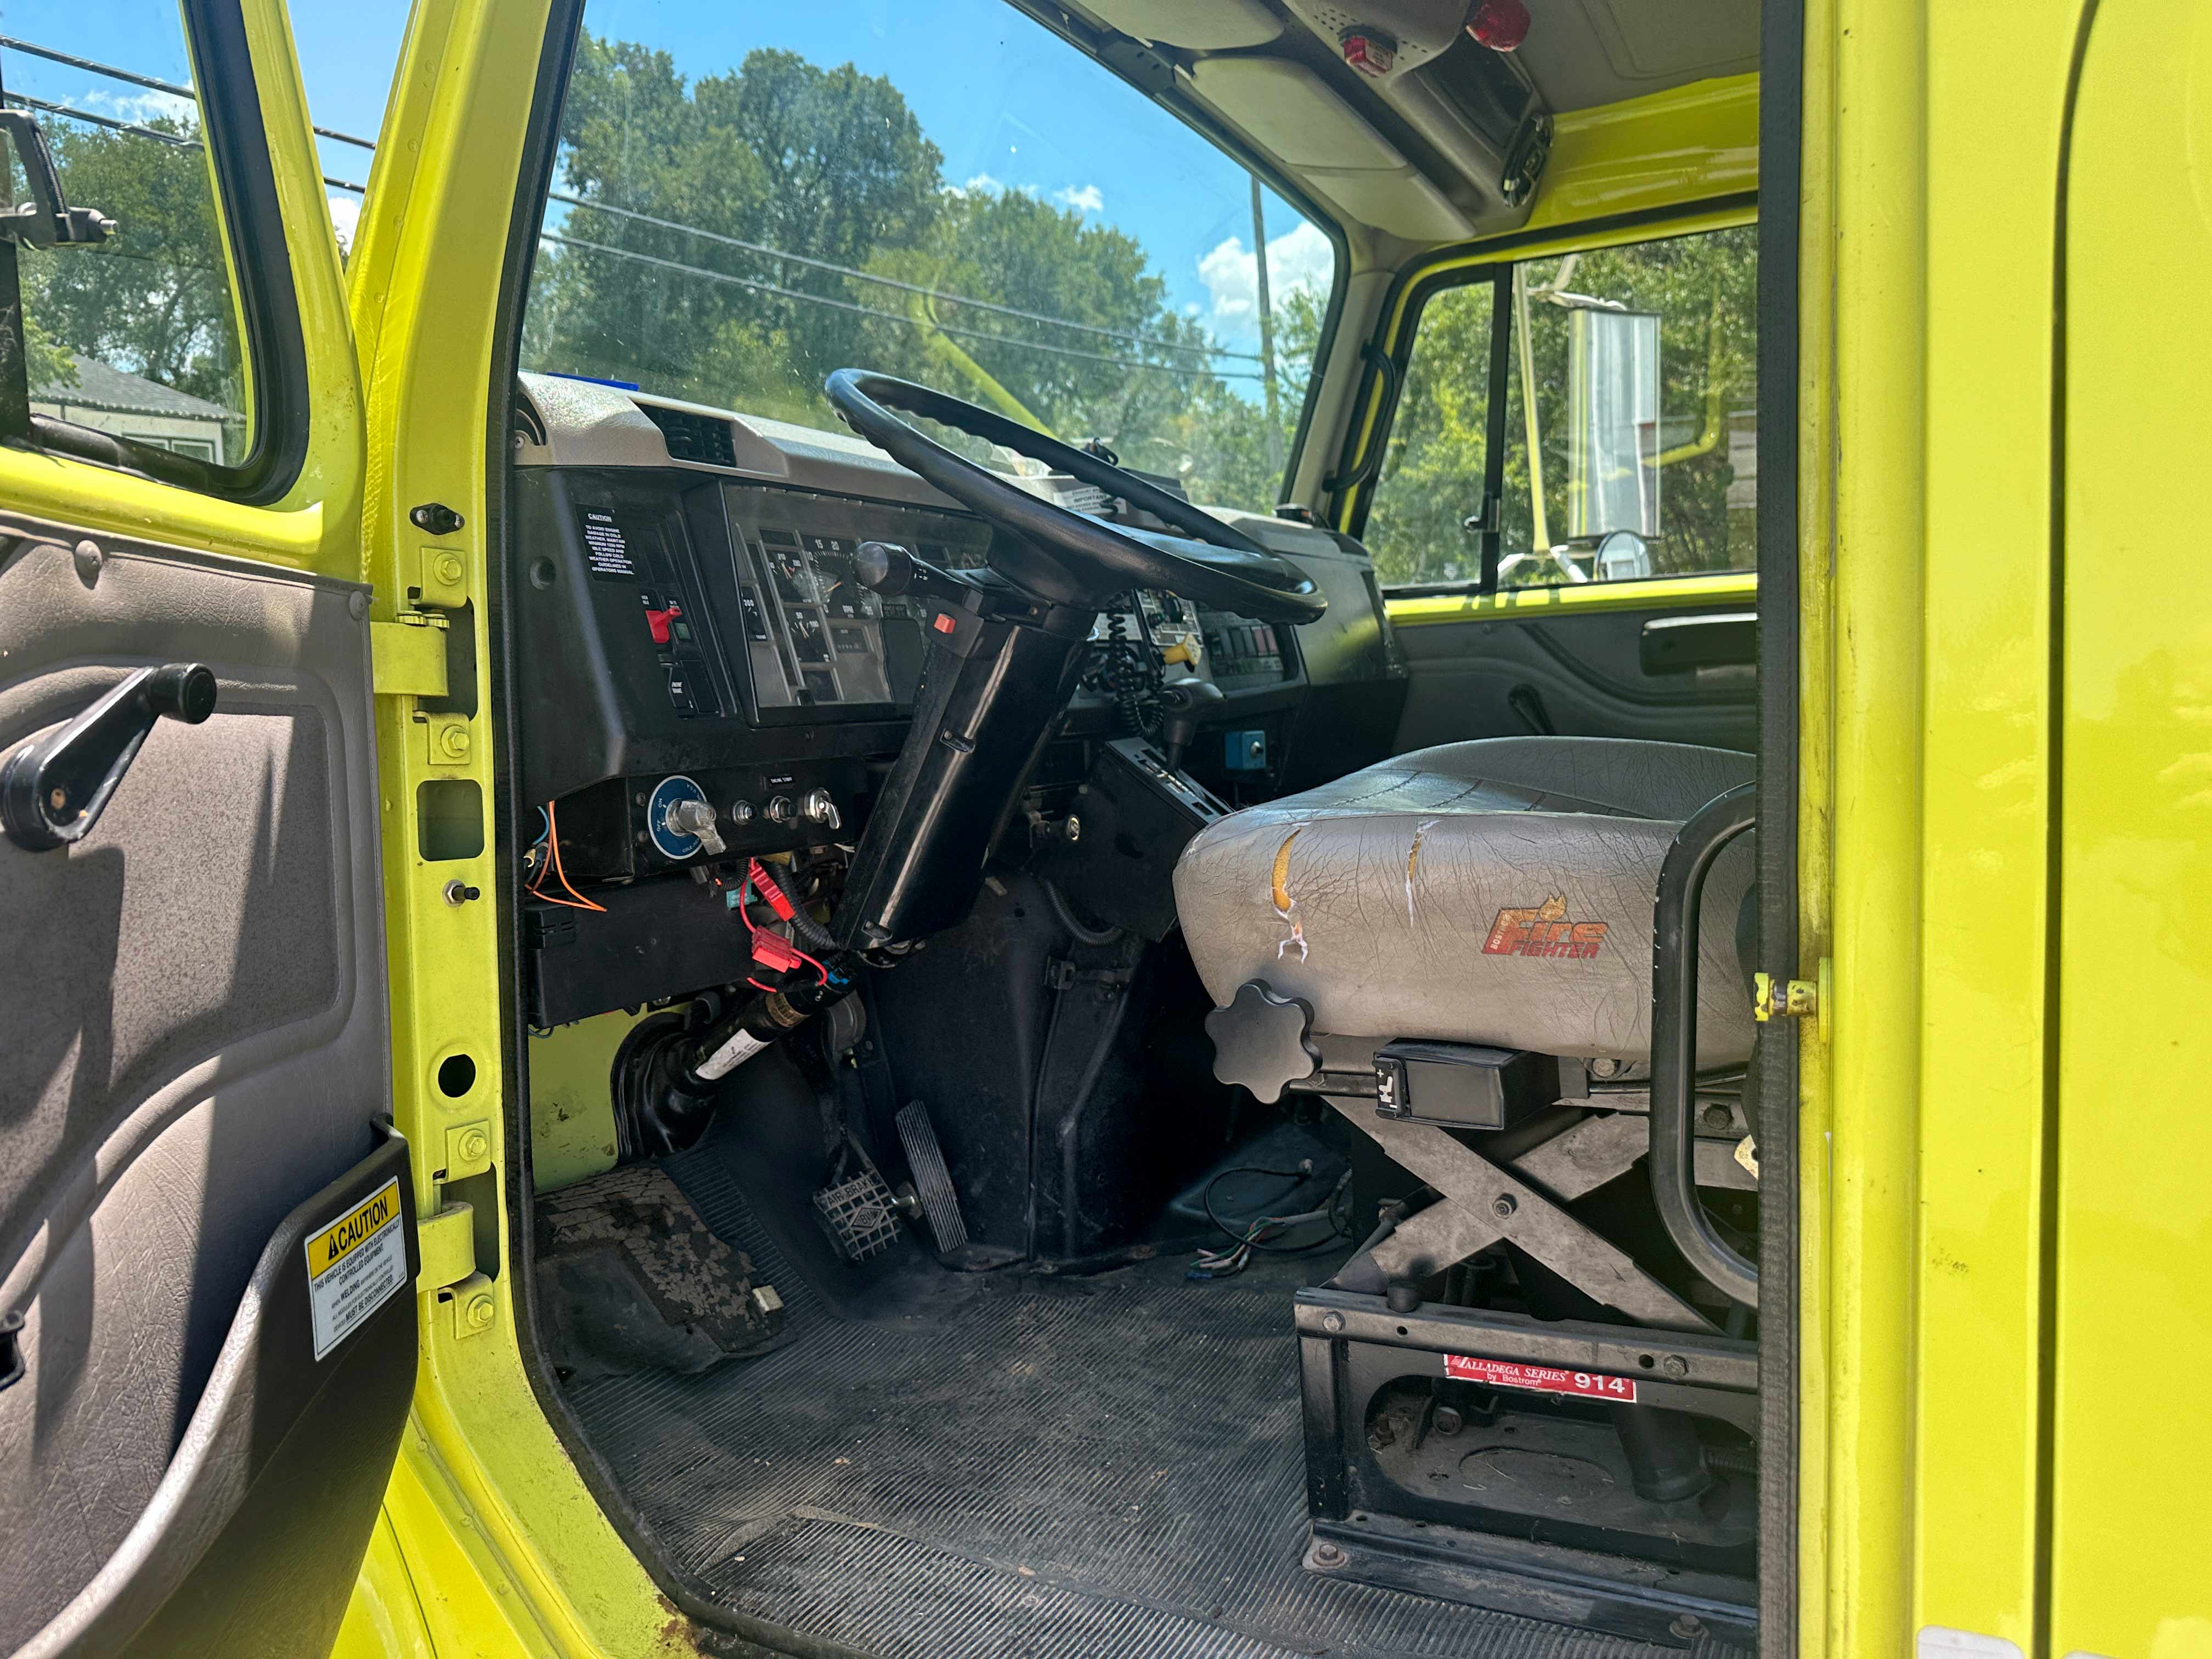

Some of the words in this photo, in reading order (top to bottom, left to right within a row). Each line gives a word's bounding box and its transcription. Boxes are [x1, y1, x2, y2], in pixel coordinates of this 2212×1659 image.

[588, 513, 612, 522] CAUTION
[815, 539, 823, 549] 15
[831, 541, 839, 550] 20
[806, 551, 814, 561] 10
[658, 798, 663, 808] ON
[1513, 941, 1600, 958] FIGHTER
[827, 1191, 844, 1205] AIR
[338, 1196, 388, 1251] CAUTION
[314, 1280, 324, 1293] THIS
[324, 1265, 342, 1285] VEHICLE
[341, 1261, 346, 1272] IS
[346, 1248, 364, 1269] EQUIPPED
[364, 1242, 374, 1254] WITH
[374, 1219, 400, 1246] ELECTRONICALLY
[338, 1263, 364, 1285] CONTROLLED
[341, 1280, 360, 1301] WELDING
[338, 1302, 352, 1316] MODULES
[346, 1305, 358, 1322] MUST
[358, 1301, 365, 1311] BE
[1487, 1373, 1497, 1381] by
[1574, 1373, 1625, 1393] 914
